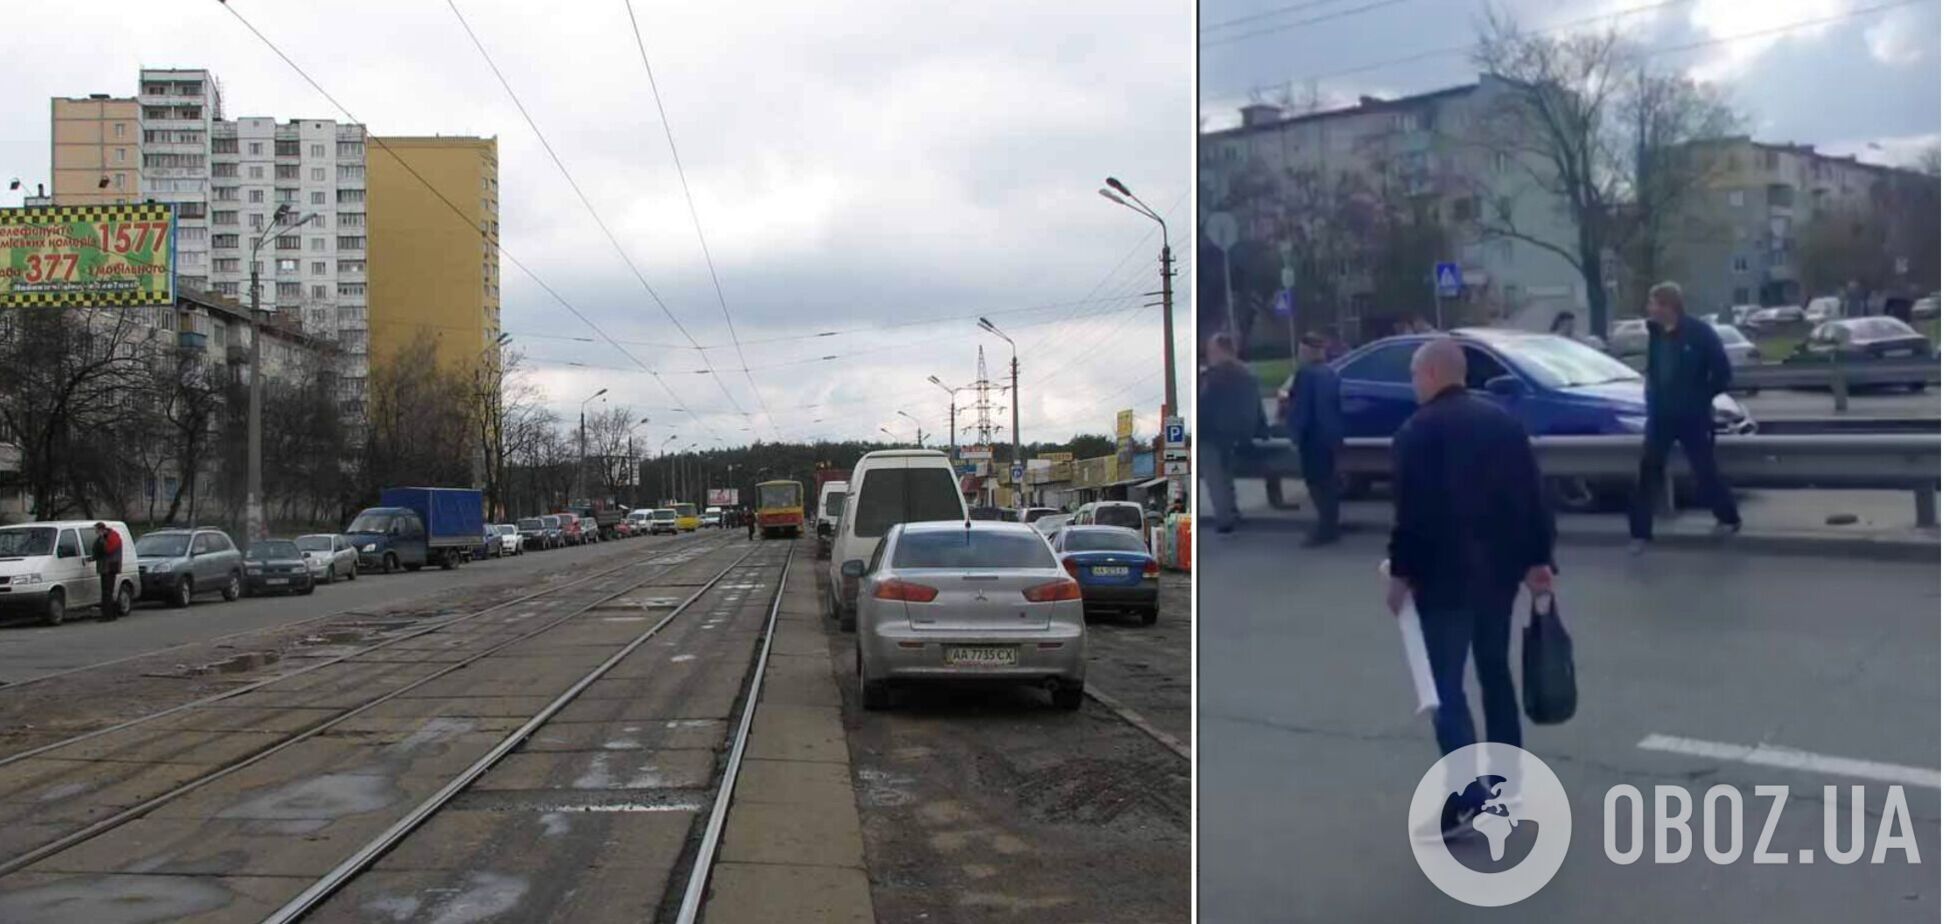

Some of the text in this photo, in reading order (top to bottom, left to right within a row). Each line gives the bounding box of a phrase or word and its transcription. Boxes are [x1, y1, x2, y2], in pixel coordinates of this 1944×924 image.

[100, 223, 168, 253] 1577
[26, 254, 79, 282] 377
[1170, 427, 1180, 441] P
[953, 649, 968, 660] AA
